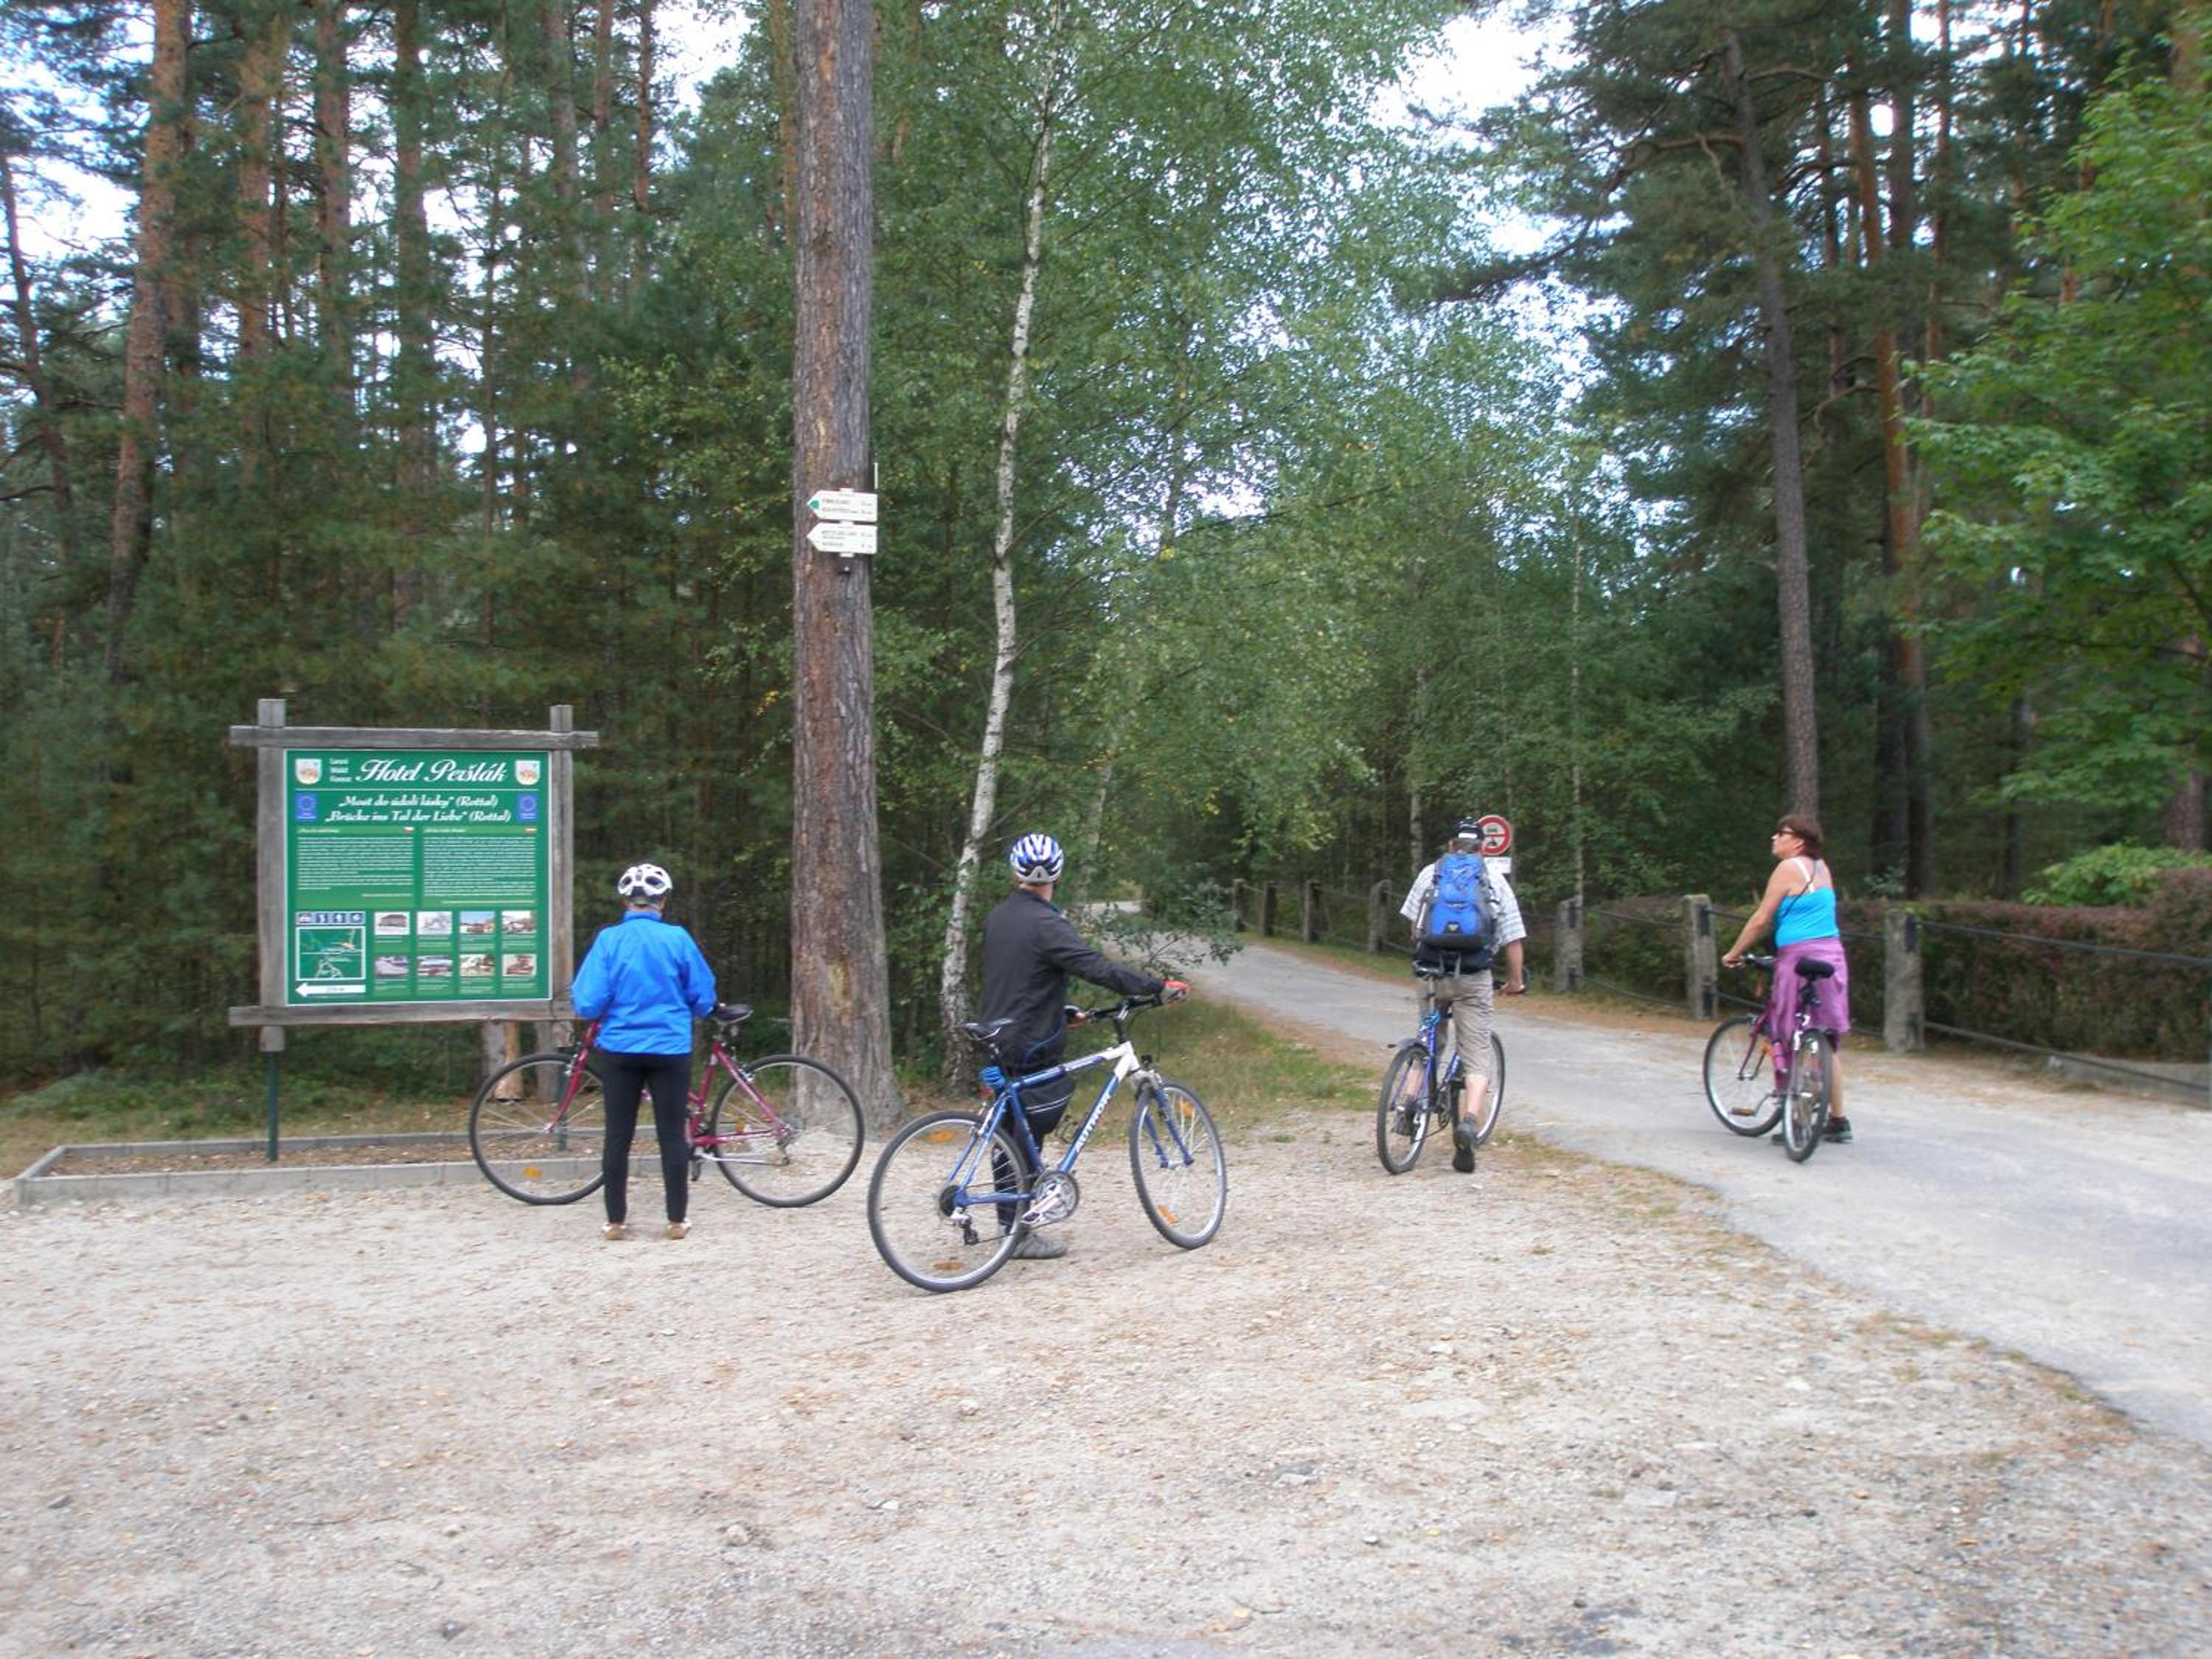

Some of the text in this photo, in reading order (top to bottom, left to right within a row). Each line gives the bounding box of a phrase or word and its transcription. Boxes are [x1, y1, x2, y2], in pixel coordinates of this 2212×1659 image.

[355, 759, 507, 782] Hotel Peršlák
[455, 794, 498, 808] (Rottal)
[391, 810, 410, 821] Tal
[411, 810, 431, 821] der
[470, 810, 512, 823] (Rottal)
[1074, 1093, 1111, 1152] AUTHOR
